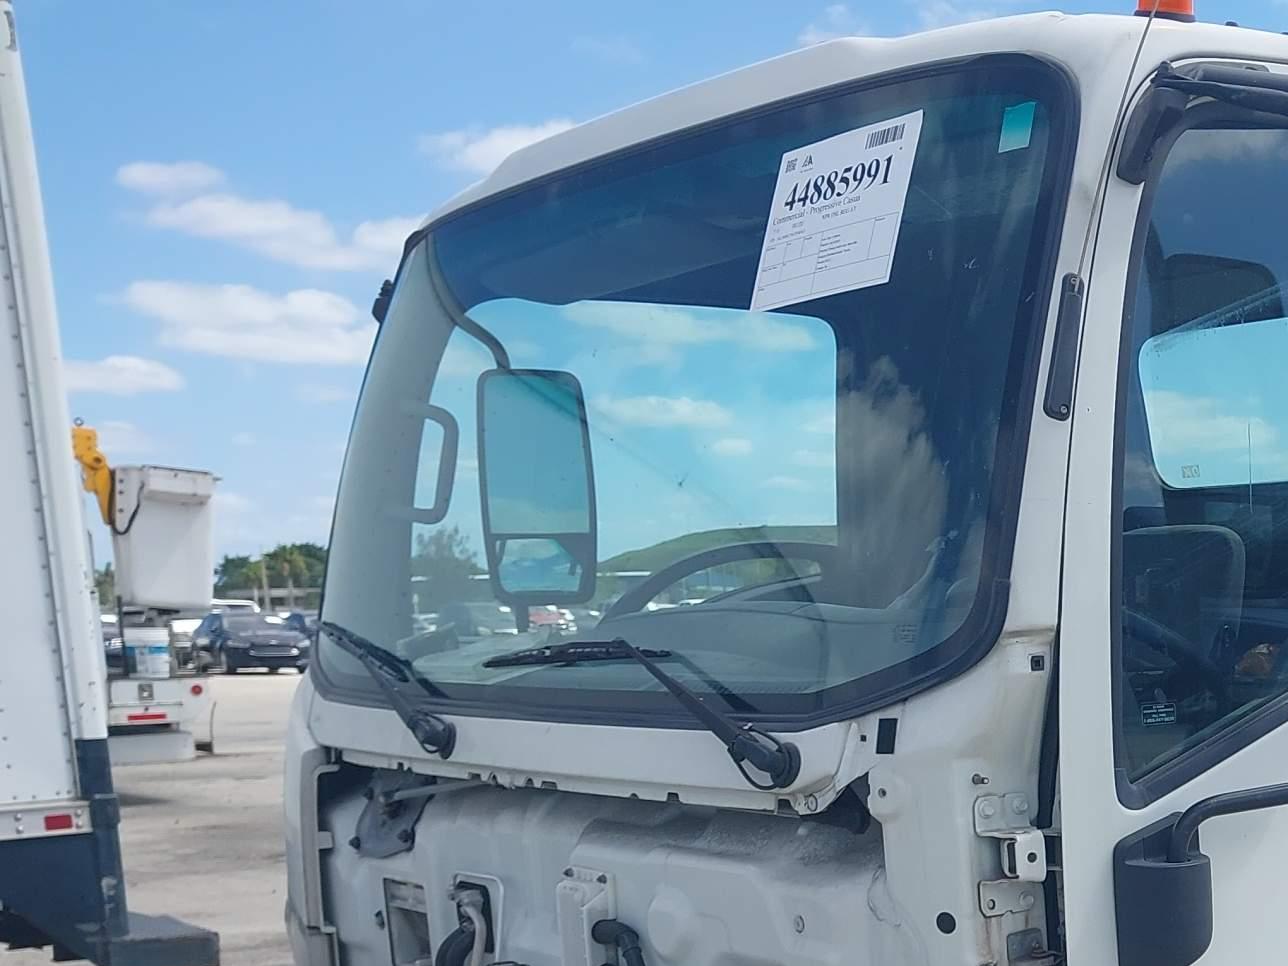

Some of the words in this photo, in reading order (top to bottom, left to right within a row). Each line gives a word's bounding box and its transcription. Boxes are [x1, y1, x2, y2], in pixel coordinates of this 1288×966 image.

[784, 154, 893, 211] 44885991
[773, 209, 805, 225] Commercial
[810, 201, 841, 215] Progressive
